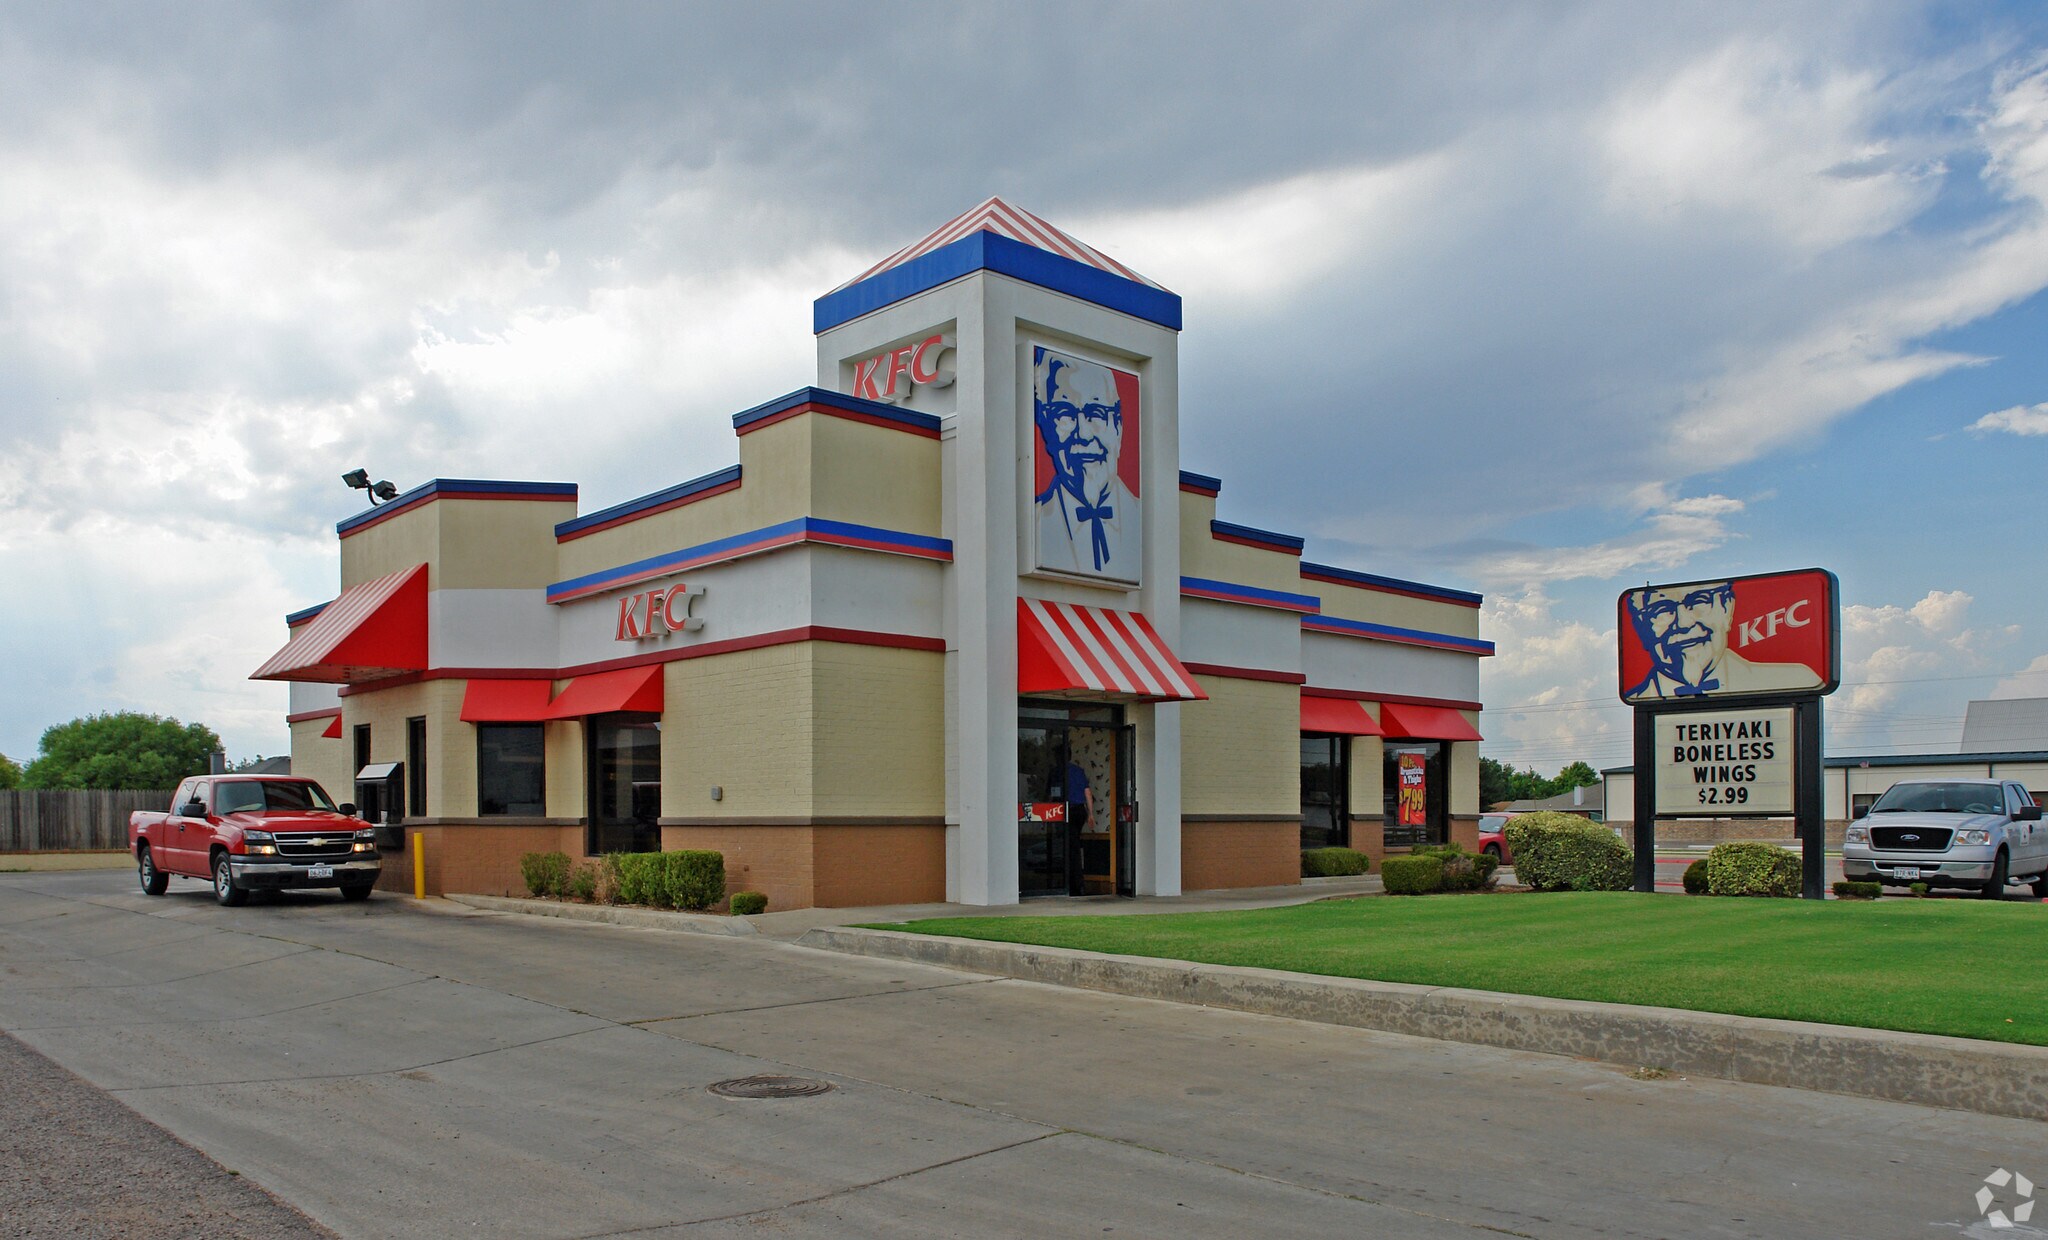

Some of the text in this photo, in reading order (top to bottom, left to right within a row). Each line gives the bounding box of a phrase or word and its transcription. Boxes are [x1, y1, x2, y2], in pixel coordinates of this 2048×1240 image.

[852, 334, 943, 400] KFC
[615, 583, 687, 641] KFC
[1739, 599, 1811, 648] KFC
[1675, 720, 1771, 741] TERIYAKI
[1674, 742, 1774, 763] BONELESS
[1693, 764, 1757, 784] WINGS
[1698, 786, 1748, 805] $2.99
[1045, 804, 1064, 820] KFC
